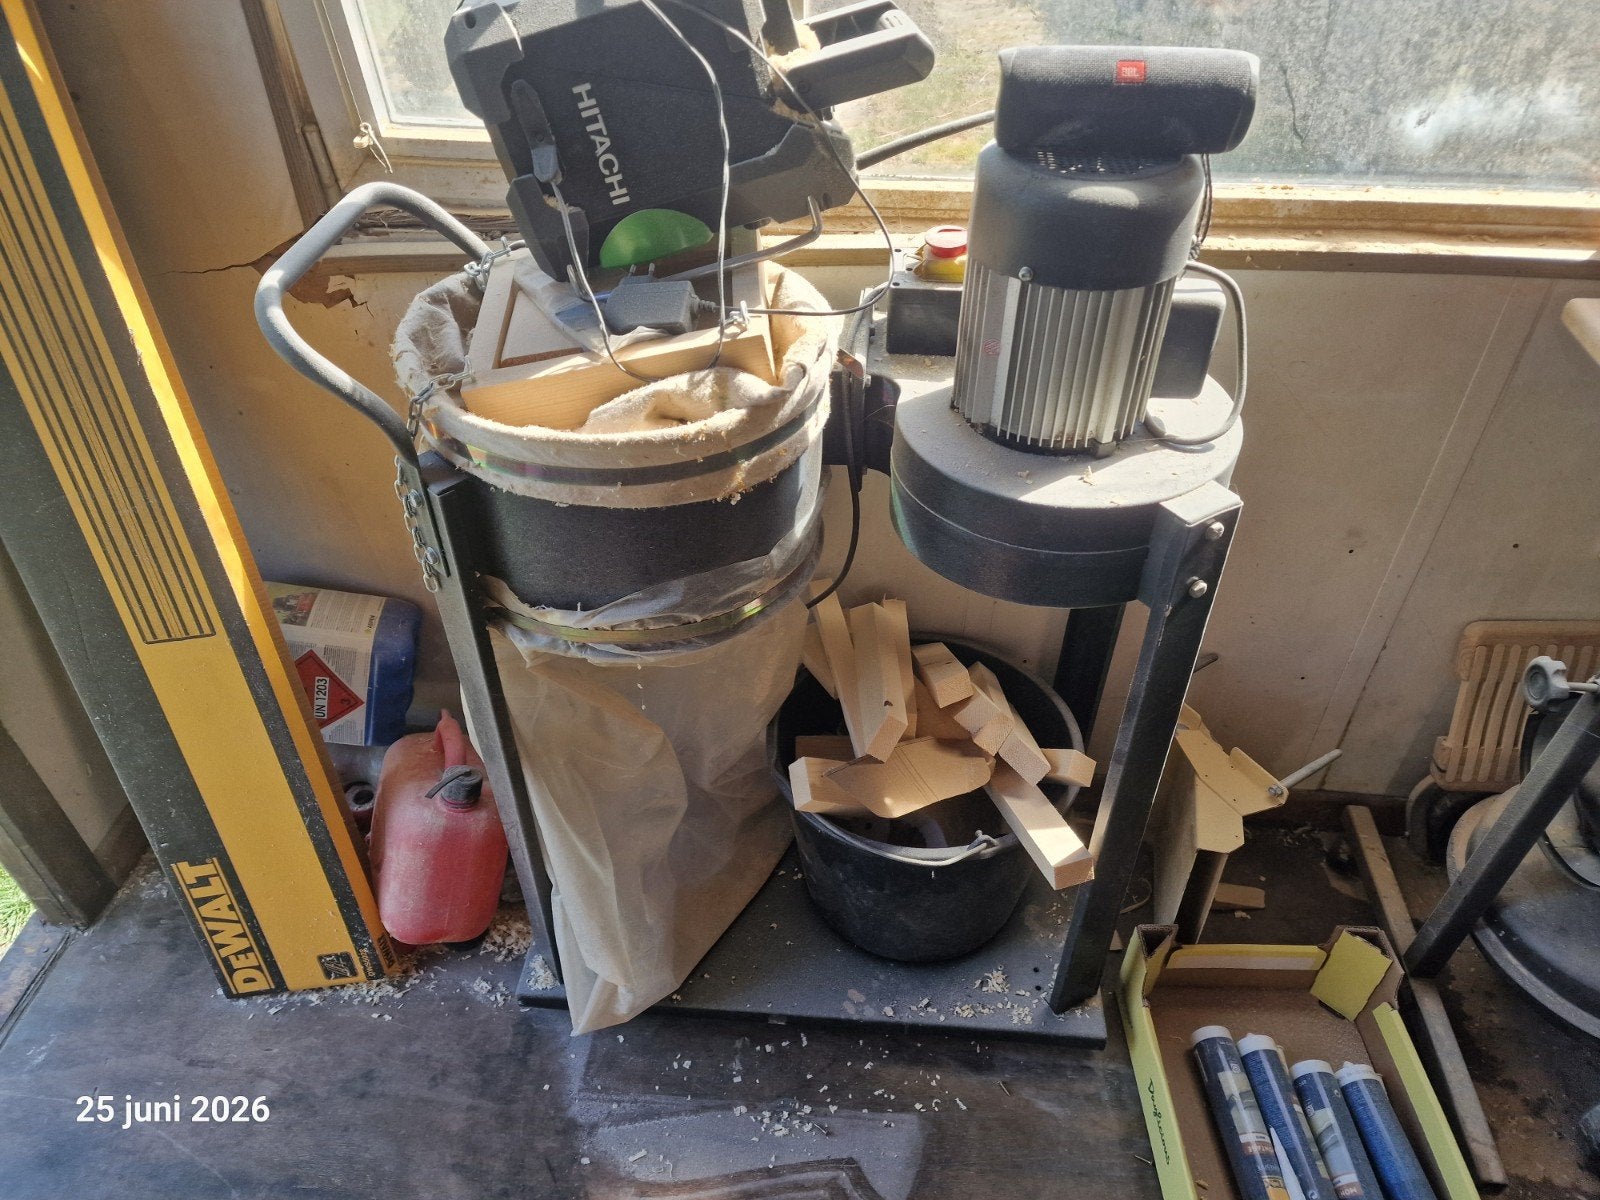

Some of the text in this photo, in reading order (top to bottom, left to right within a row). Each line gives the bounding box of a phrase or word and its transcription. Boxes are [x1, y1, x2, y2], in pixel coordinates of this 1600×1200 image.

[1121, 66, 1140, 77] JBL
[572, 82, 631, 206] HITACHI
[315, 678, 328, 718] UN 1203
[176, 860, 272, 994] DEWALT
